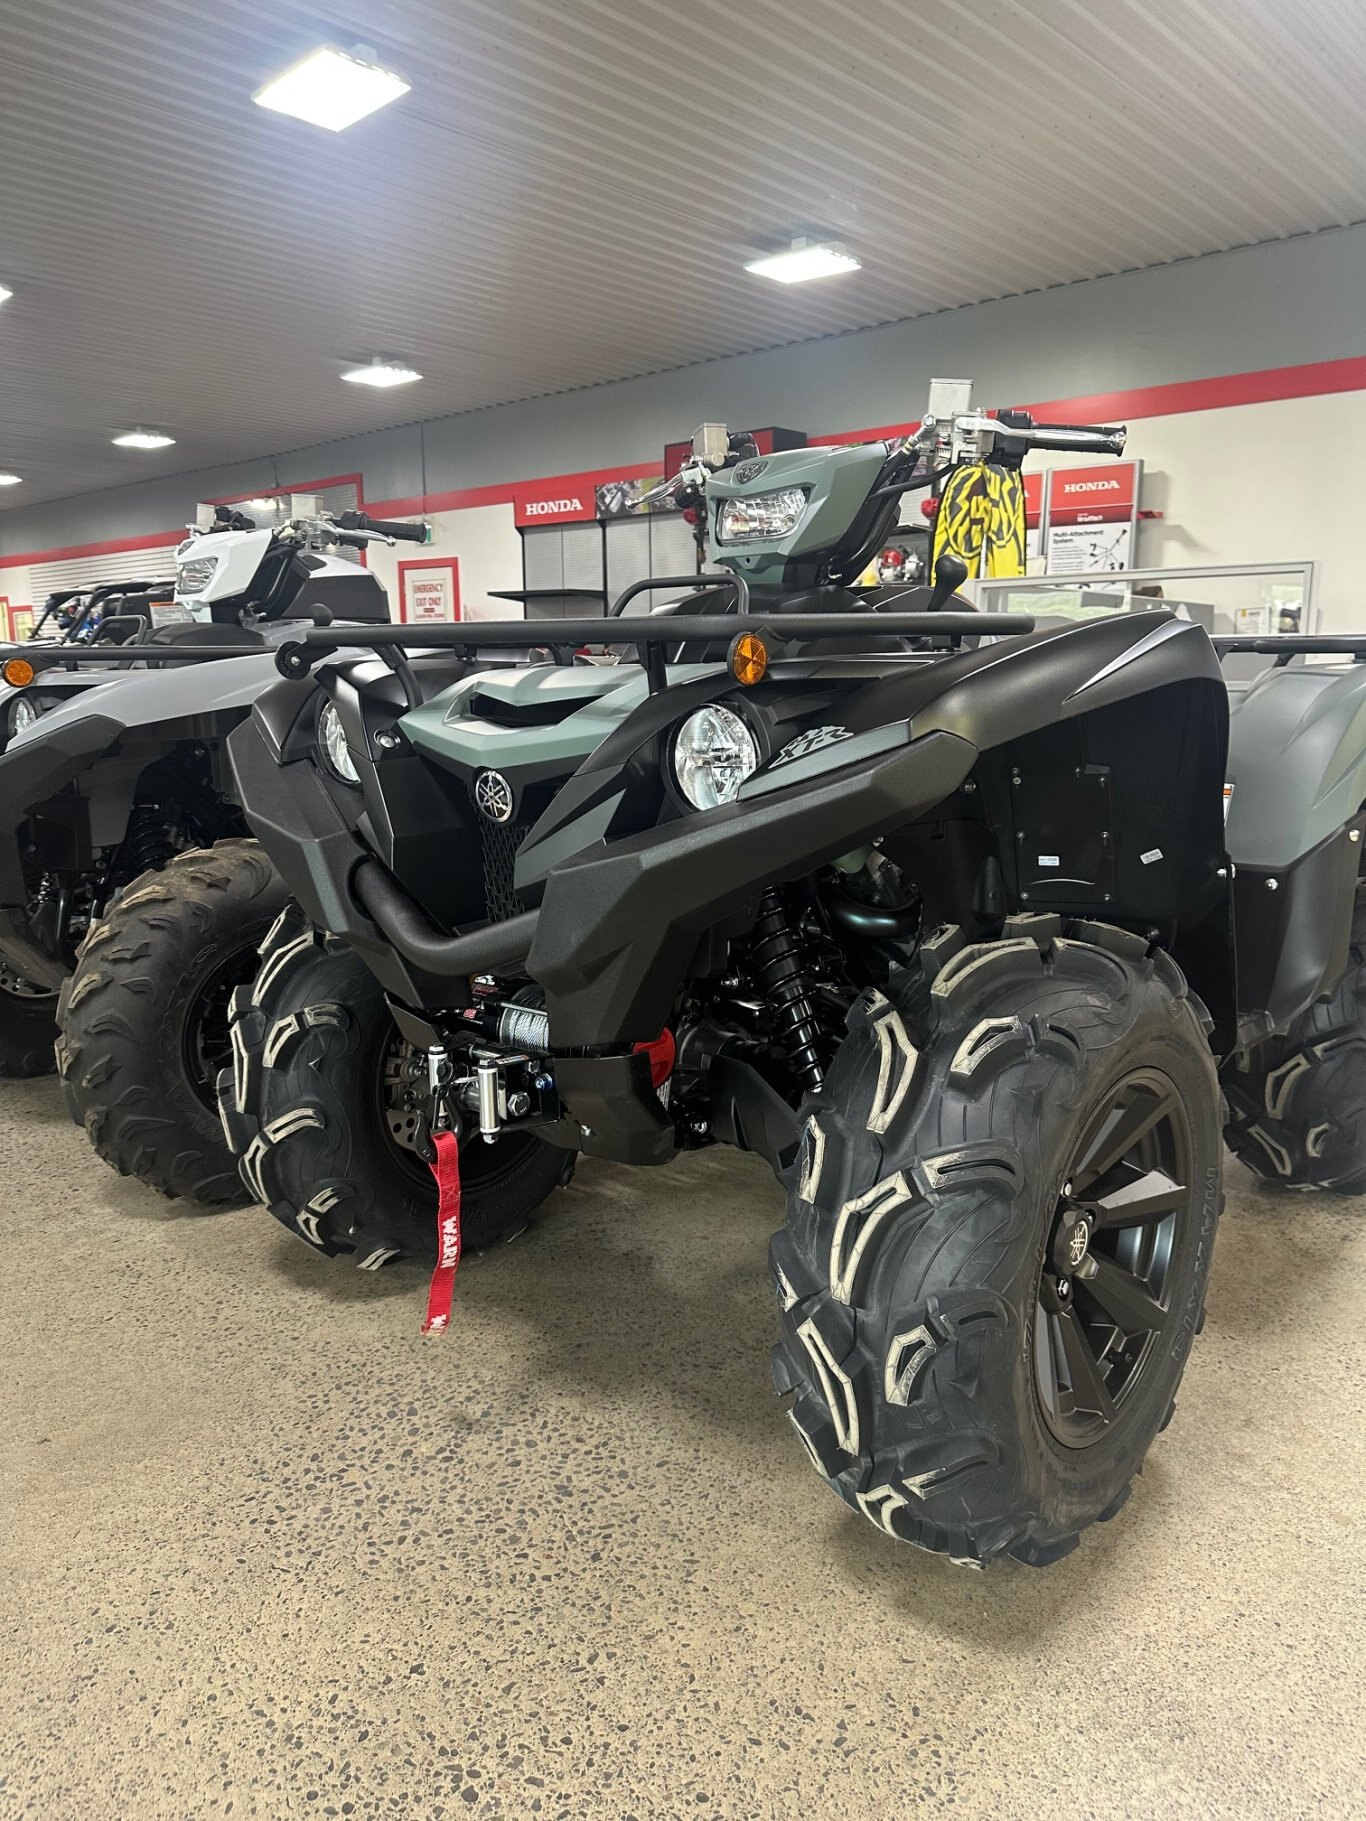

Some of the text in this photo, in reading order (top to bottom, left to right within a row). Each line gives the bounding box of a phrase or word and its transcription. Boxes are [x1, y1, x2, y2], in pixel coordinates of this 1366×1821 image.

[1063, 480, 1121, 493] HONDA
[525, 498, 584, 516] HONDA
[1053, 529, 1104, 538] Multi-Attachment
[440, 1215, 458, 1268] WARN
